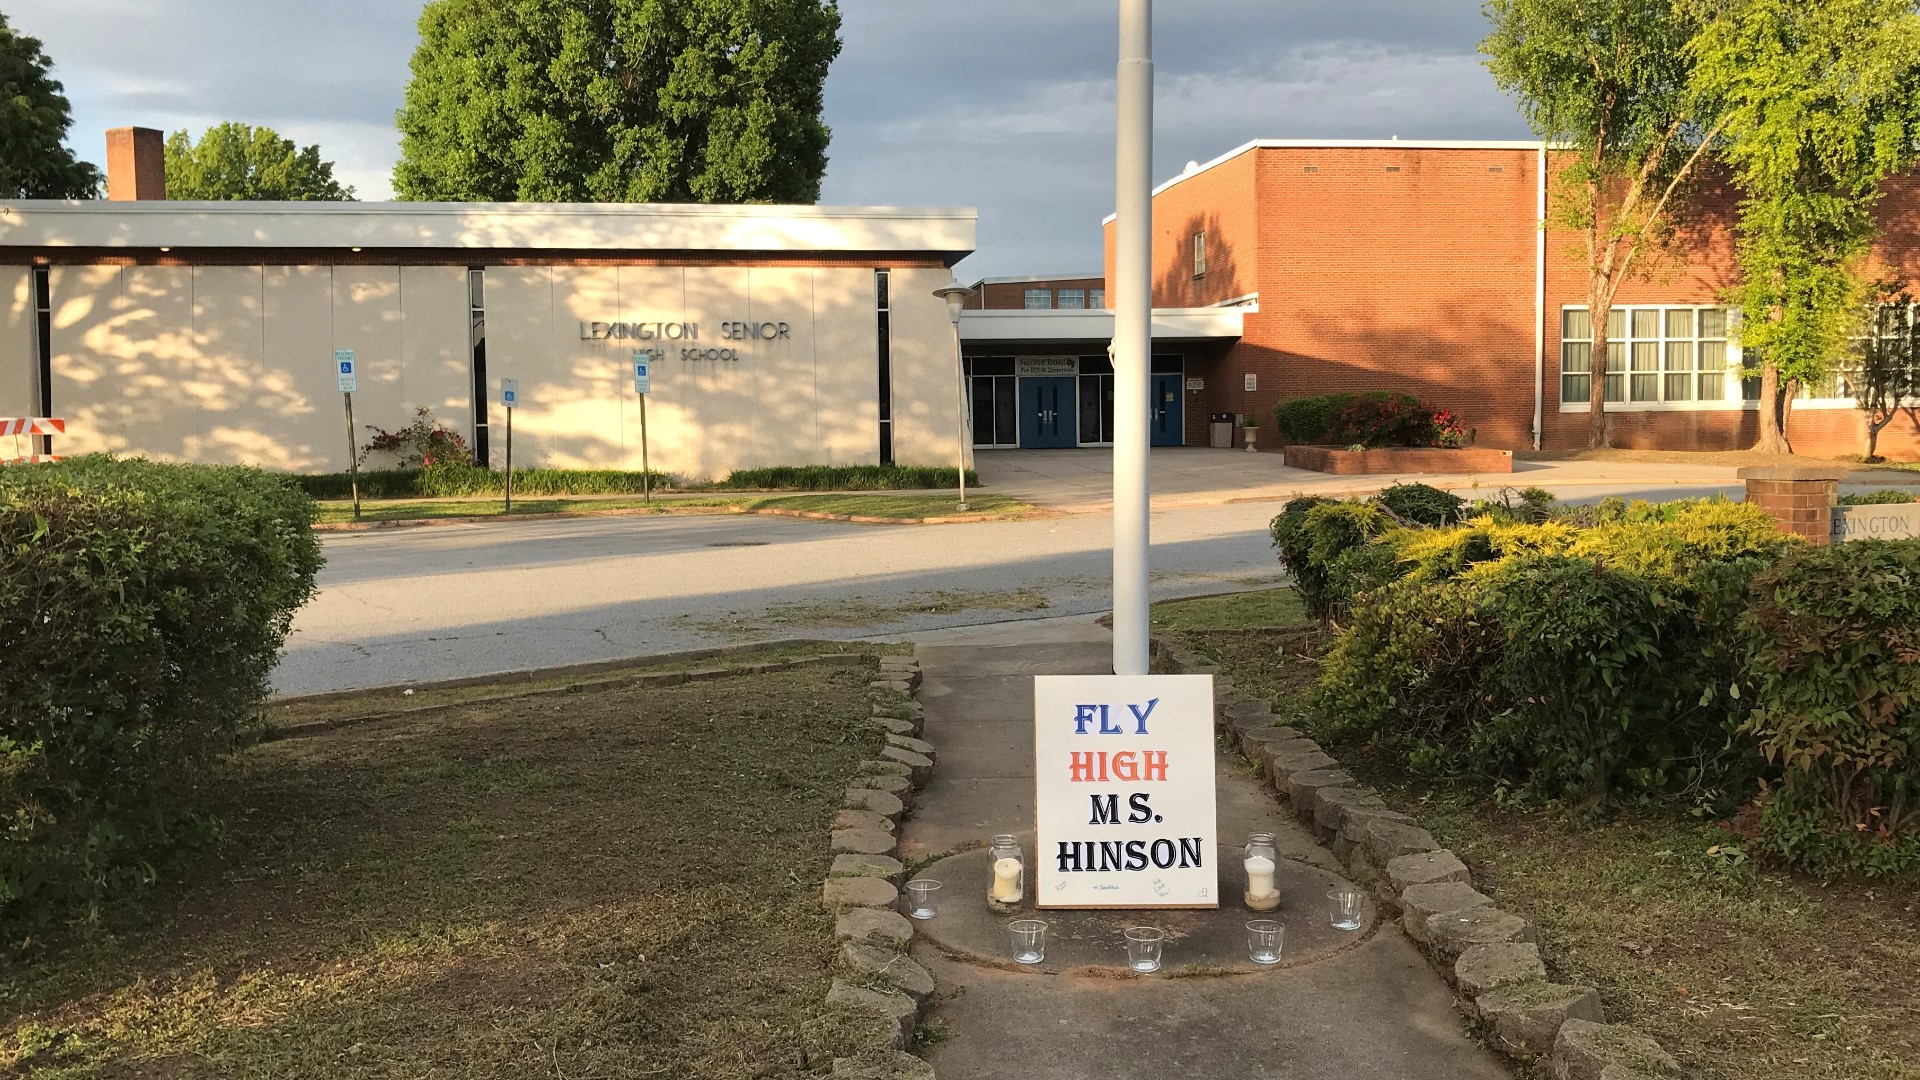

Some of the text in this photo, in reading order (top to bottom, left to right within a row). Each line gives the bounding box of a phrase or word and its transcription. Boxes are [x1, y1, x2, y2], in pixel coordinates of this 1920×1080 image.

[580, 322, 790, 340] LEXINGTON SENIOR
[681, 348, 739, 361] SCHOOL
[1833, 516, 1910, 535] EXINGTON
[1074, 697, 1160, 735] FLY
[1069, 751, 1169, 782] HIGH
[1089, 793, 1163, 825] MS.
[1056, 837, 1203, 873] HINSON
[1054, 880, 1068, 893] RIP
